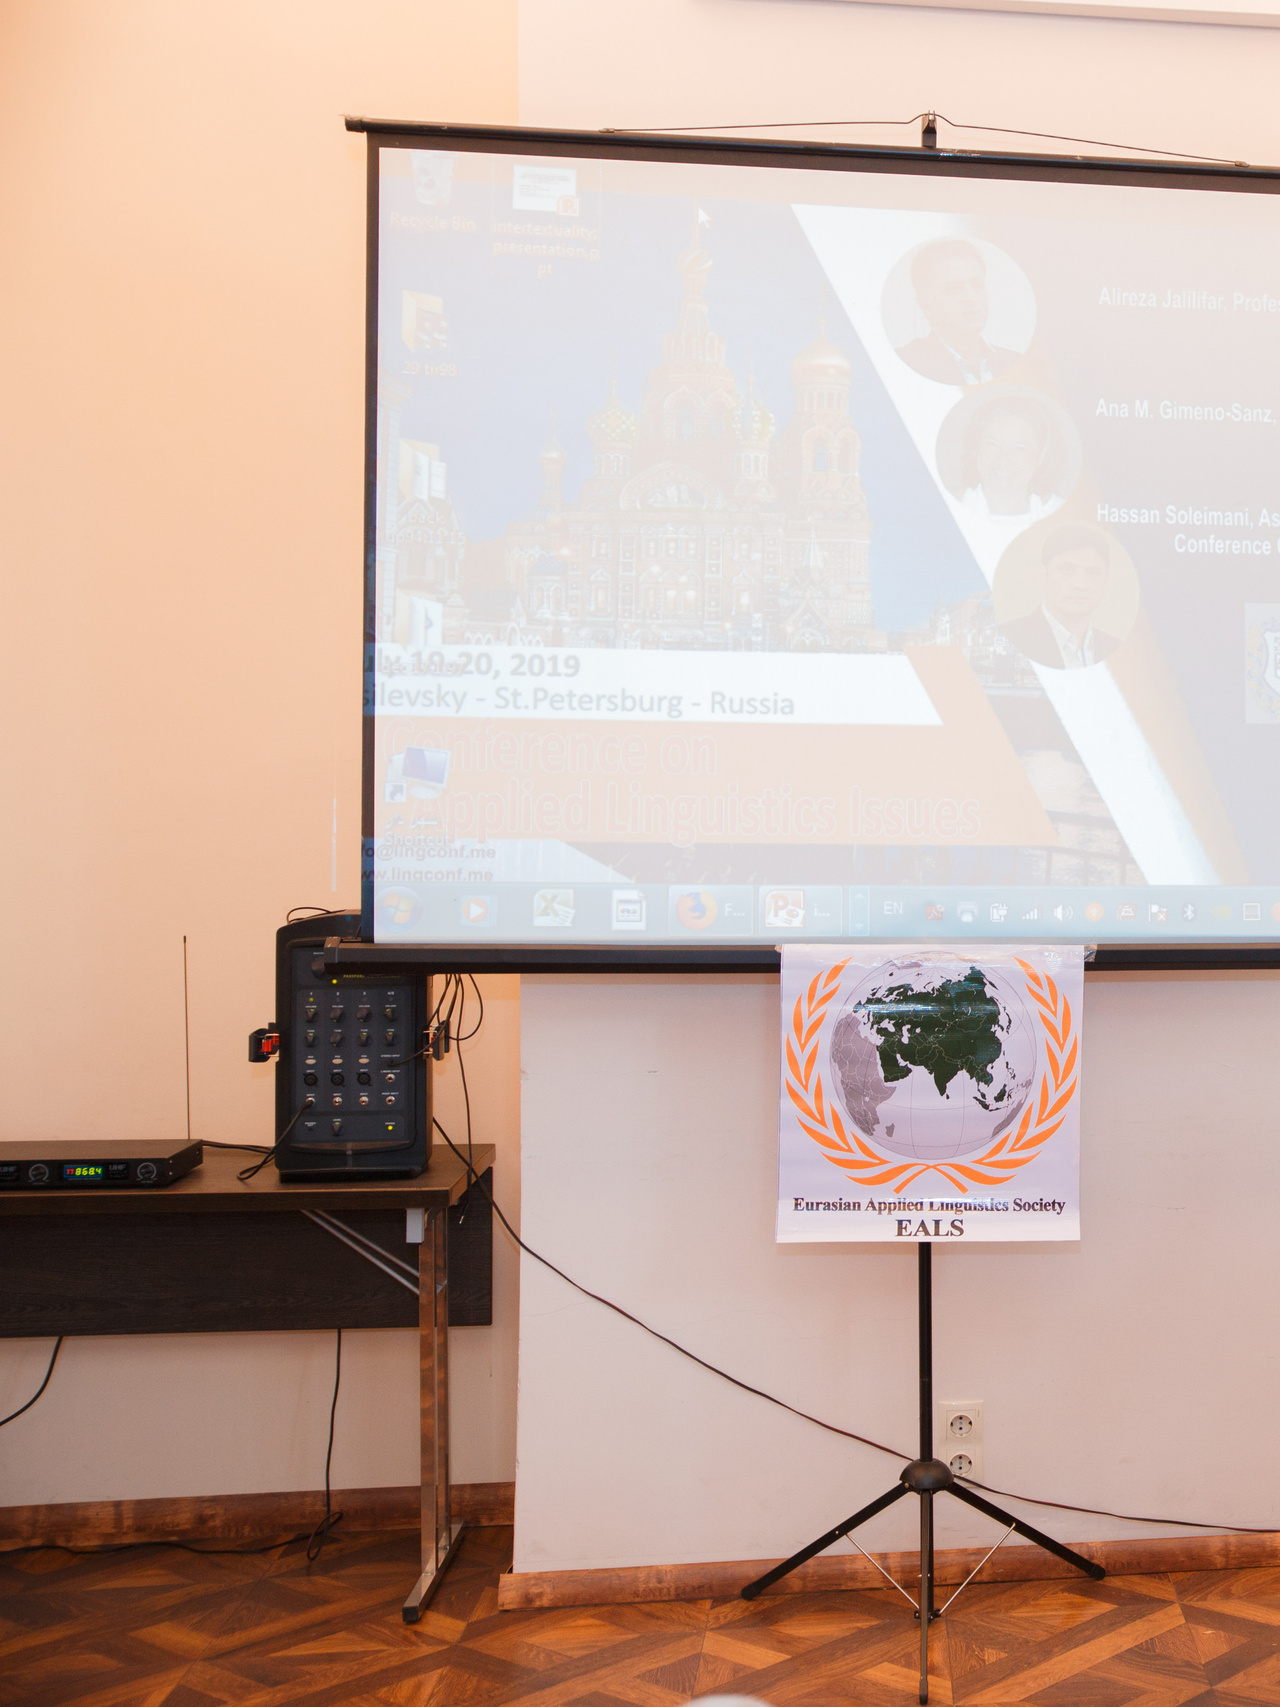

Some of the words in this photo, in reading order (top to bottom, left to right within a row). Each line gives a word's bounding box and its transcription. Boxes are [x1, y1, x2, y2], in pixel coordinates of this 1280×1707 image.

[390, 212, 448, 233] Recycle
[452, 216, 477, 232] Bin
[1098, 286, 1157, 308] Alireza
[1162, 289, 1228, 312] Jalilifar,
[1095, 397, 1129, 417] Ana
[1135, 400, 1154, 418] M.
[1159, 401, 1277, 425] Gimeno-Sanz,
[1097, 502, 1160, 524] Hassan
[1165, 505, 1254, 529] Soleimani,
[1174, 533, 1271, 555] Conference
[510, 653, 581, 678] 2019
[494, 685, 683, 719] St.Petersburg
[710, 691, 796, 716] Russia
[660, 731, 718, 777] on
[409, 777, 592, 845] Applied
[604, 780, 837, 847] Linguistics
[847, 785, 982, 839] Issues
[385, 831, 450, 846] Shortcut
[361, 845, 496, 862] o@lingconf.me
[884, 901, 904, 915] EN
[793, 1197, 862, 1211] Eurasian
[865, 1197, 923, 1215] Applied
[929, 1197, 1009, 1215] Linguistics
[1013, 1197, 1066, 1215] Society
[895, 1219, 965, 1237] EALS
